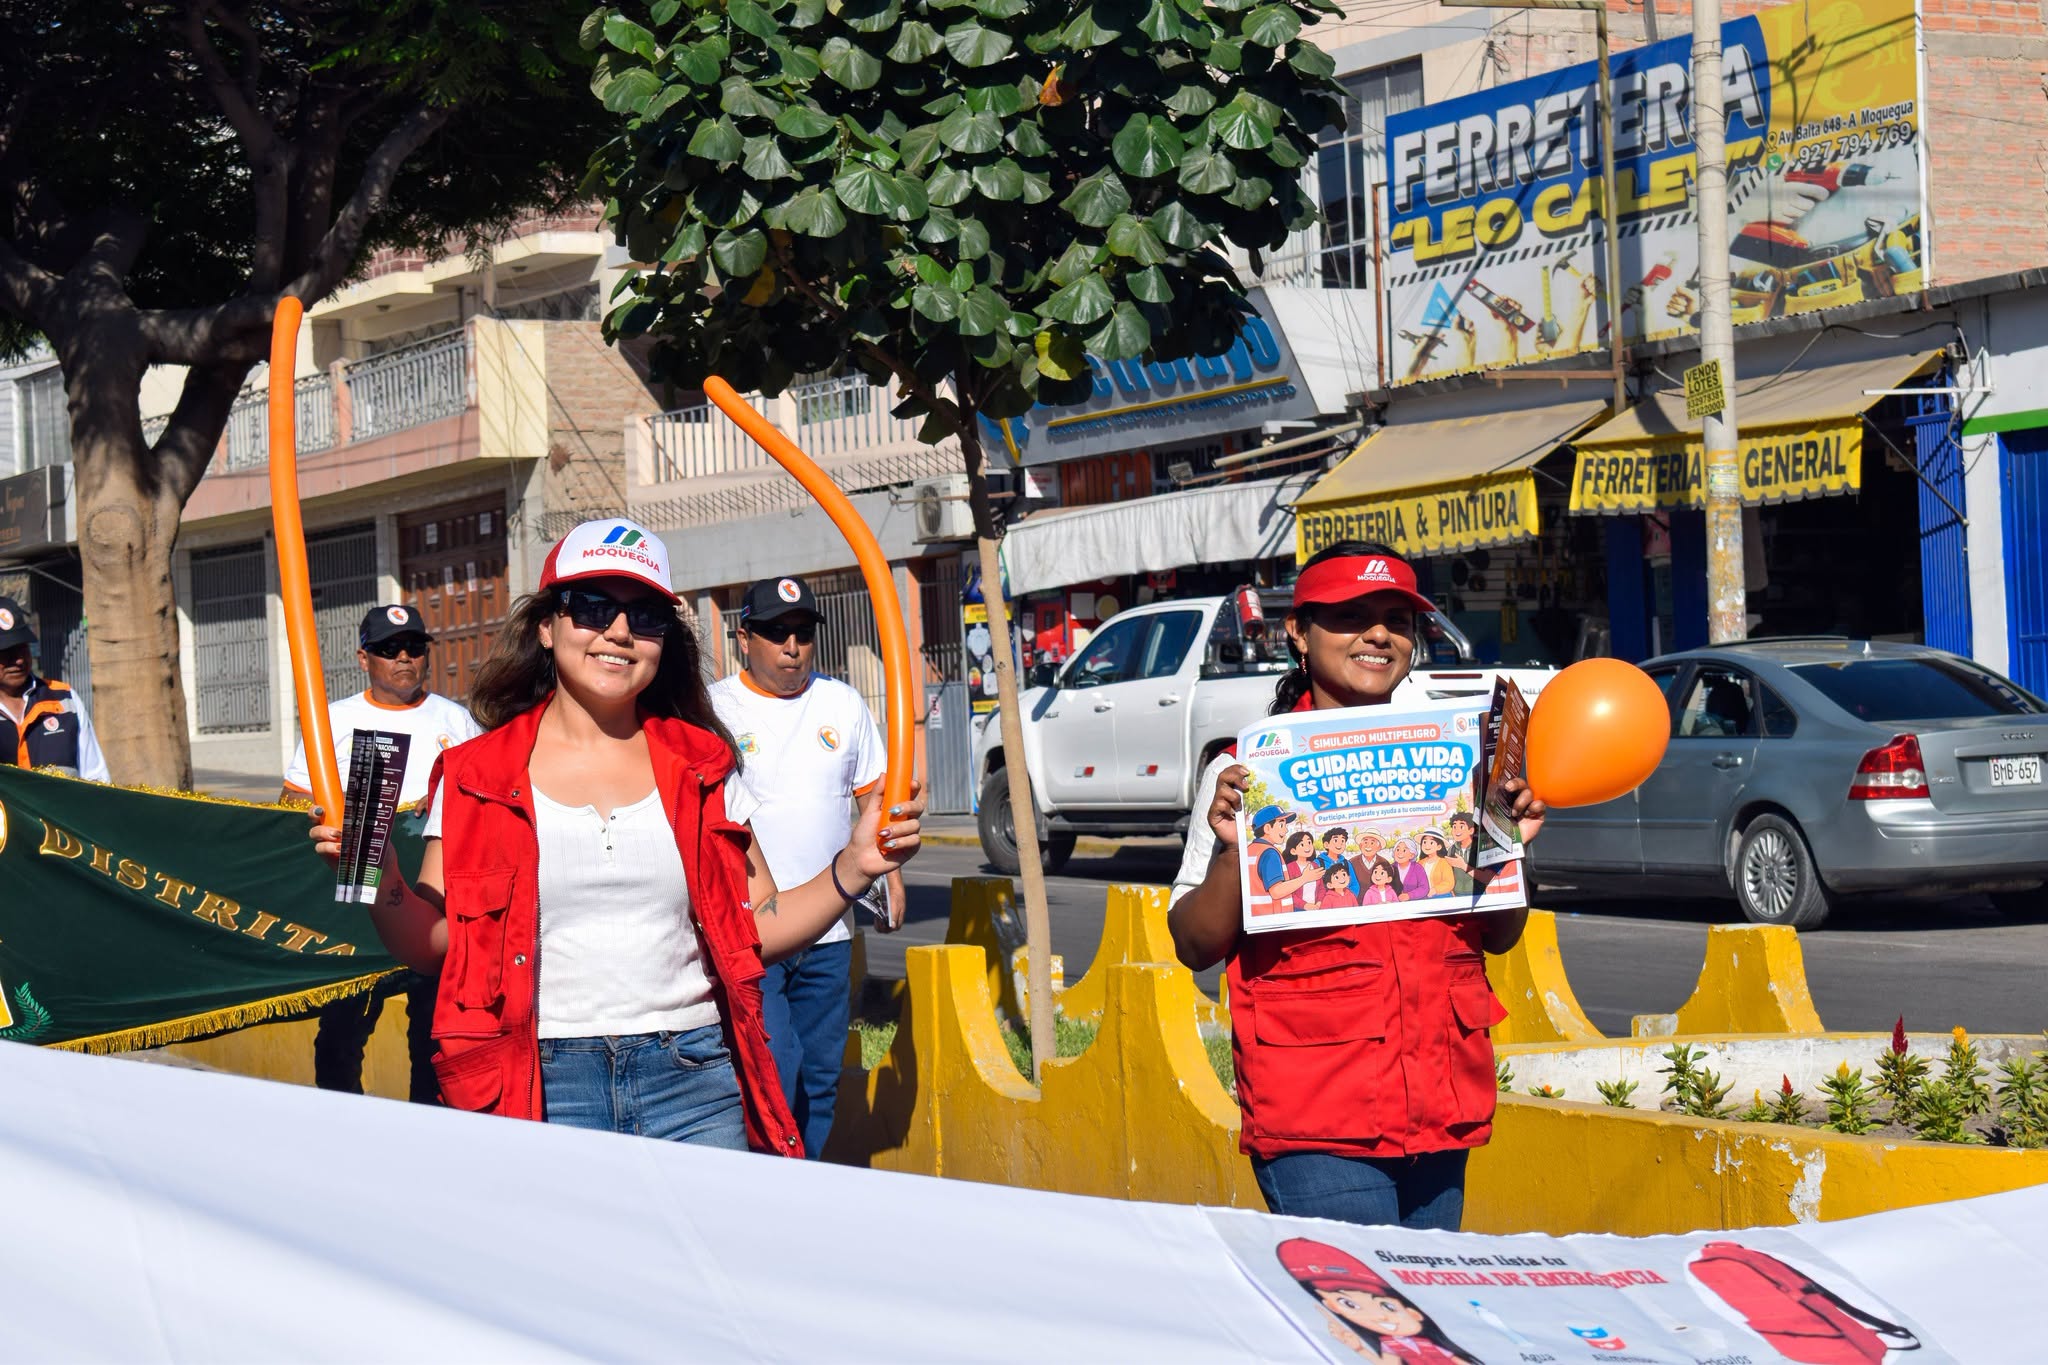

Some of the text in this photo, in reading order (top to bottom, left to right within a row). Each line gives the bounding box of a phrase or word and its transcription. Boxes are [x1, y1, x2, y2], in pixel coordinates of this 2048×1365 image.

[1795, 123, 1820, 140] Balta
[1860, 101, 1913, 126] Moquegua
[1800, 122, 1912, 165] 927 794 769
[1686, 361, 1718, 382] VENDO
[1689, 374, 1719, 394] LOTES
[1580, 452, 1702, 495] FERRETERIA
[1745, 436, 1847, 488] GENERAL
[1303, 489, 1519, 553] FERRETERIA & PINTURA
[583, 548, 661, 573] MOQUEGUA
[1357, 575, 1396, 584] MOQUEGUA
[1313, 728, 1437, 749] SIMULACRO MULTIPELIGRO
[1249, 748, 1290, 759] MOQUEGUA
[1290, 746, 1466, 781] CUIDAR LA VIDA
[1993, 761, 2038, 780] BMB-657
[1296, 768, 1464, 797] ES UN COMPROMISO
[1335, 784, 1426, 807] DE TODOS
[1380, 806, 1397, 816] ayuda
[1375, 1250, 1568, 1268] Siempre ten lista tu
[1391, 1269, 1669, 1289] MOCHILA DE EMERGENCIA
[1519, 1352, 1556, 1364] Agua
